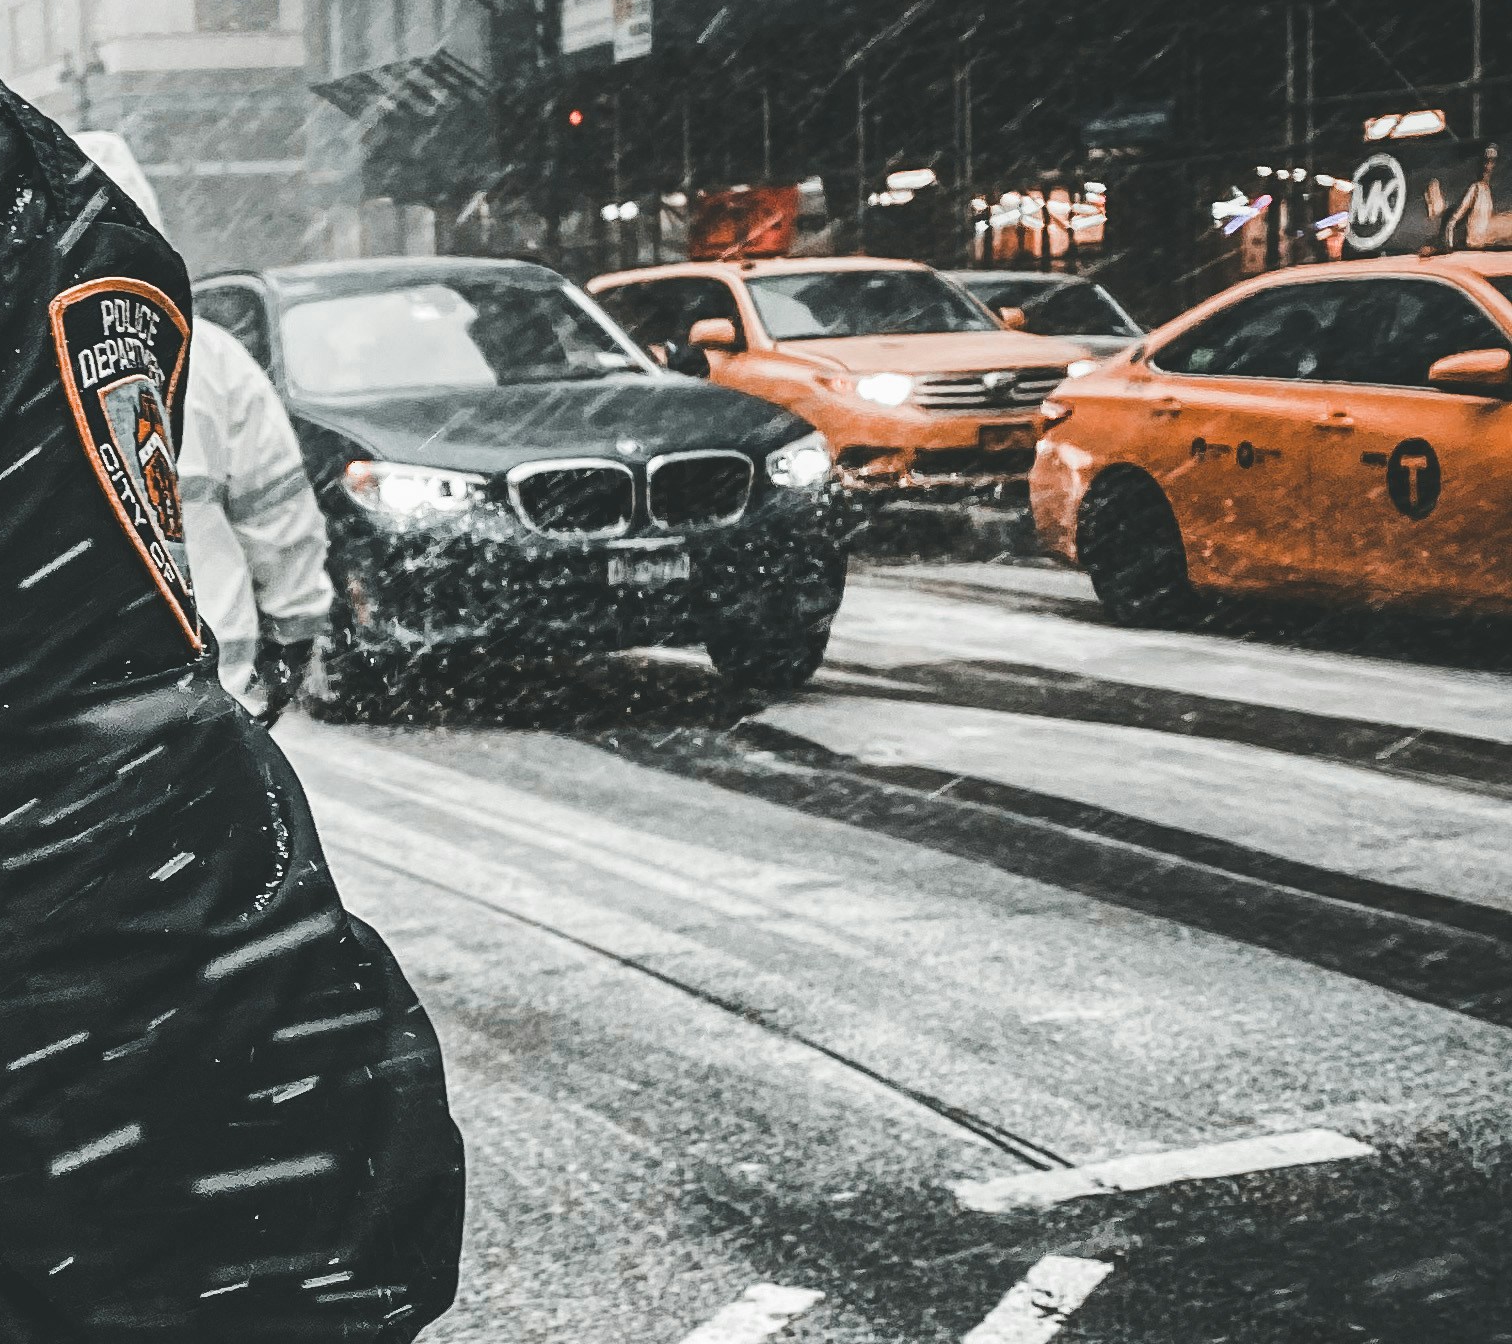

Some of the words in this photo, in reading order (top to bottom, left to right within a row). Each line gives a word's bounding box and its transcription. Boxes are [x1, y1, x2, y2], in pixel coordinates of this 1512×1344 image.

[100, 298, 161, 346] POLICE
[1399, 455, 1428, 506] T
[99, 443, 147, 527] CITY
[149, 541, 176, 583] OF
